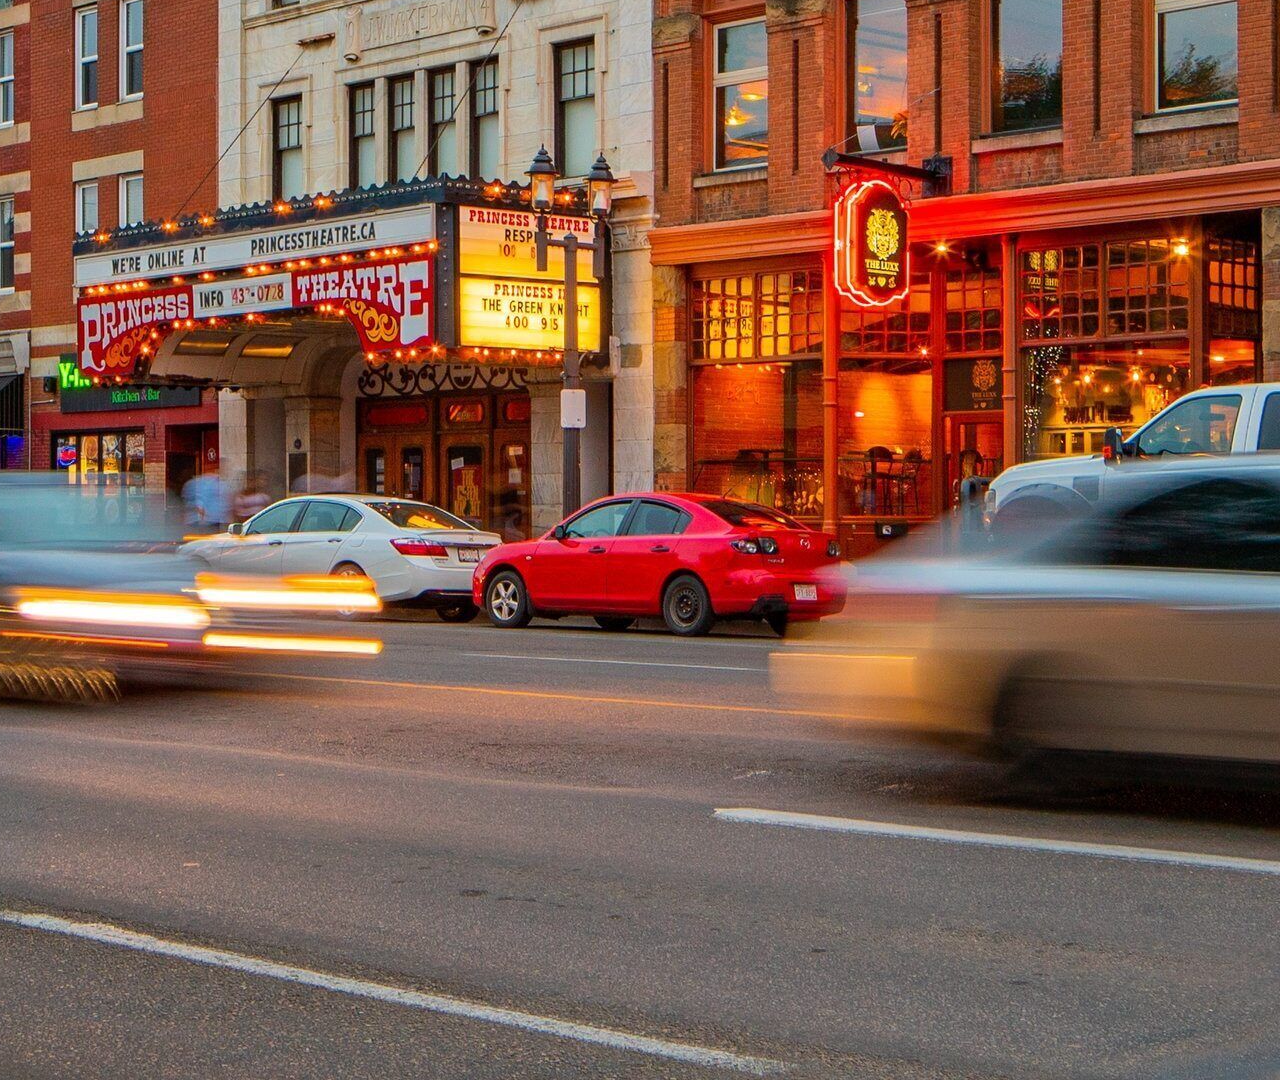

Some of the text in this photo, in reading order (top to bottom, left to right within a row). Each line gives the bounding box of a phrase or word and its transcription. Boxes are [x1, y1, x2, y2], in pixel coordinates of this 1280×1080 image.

[469, 209, 589, 233] PRINCESS EATRE
[250, 222, 376, 256] PRINCESSTHEATRE.CA
[505, 229, 553, 244] RESPT
[112, 246, 206, 275] WE'RE ONLINE AT
[865, 259, 880, 269] THE
[881, 261, 900, 272] LUXX
[199, 291, 224, 308] INFO
[494, 283, 553, 299] PRINCESS
[297, 260, 429, 345] THEATRE
[482, 298, 589, 317] THE GREEN KNHT
[81, 293, 189, 371] PRINCESS
[505, 316, 559, 331] 400 915
[111, 388, 160, 404] Kitchen & Bar
